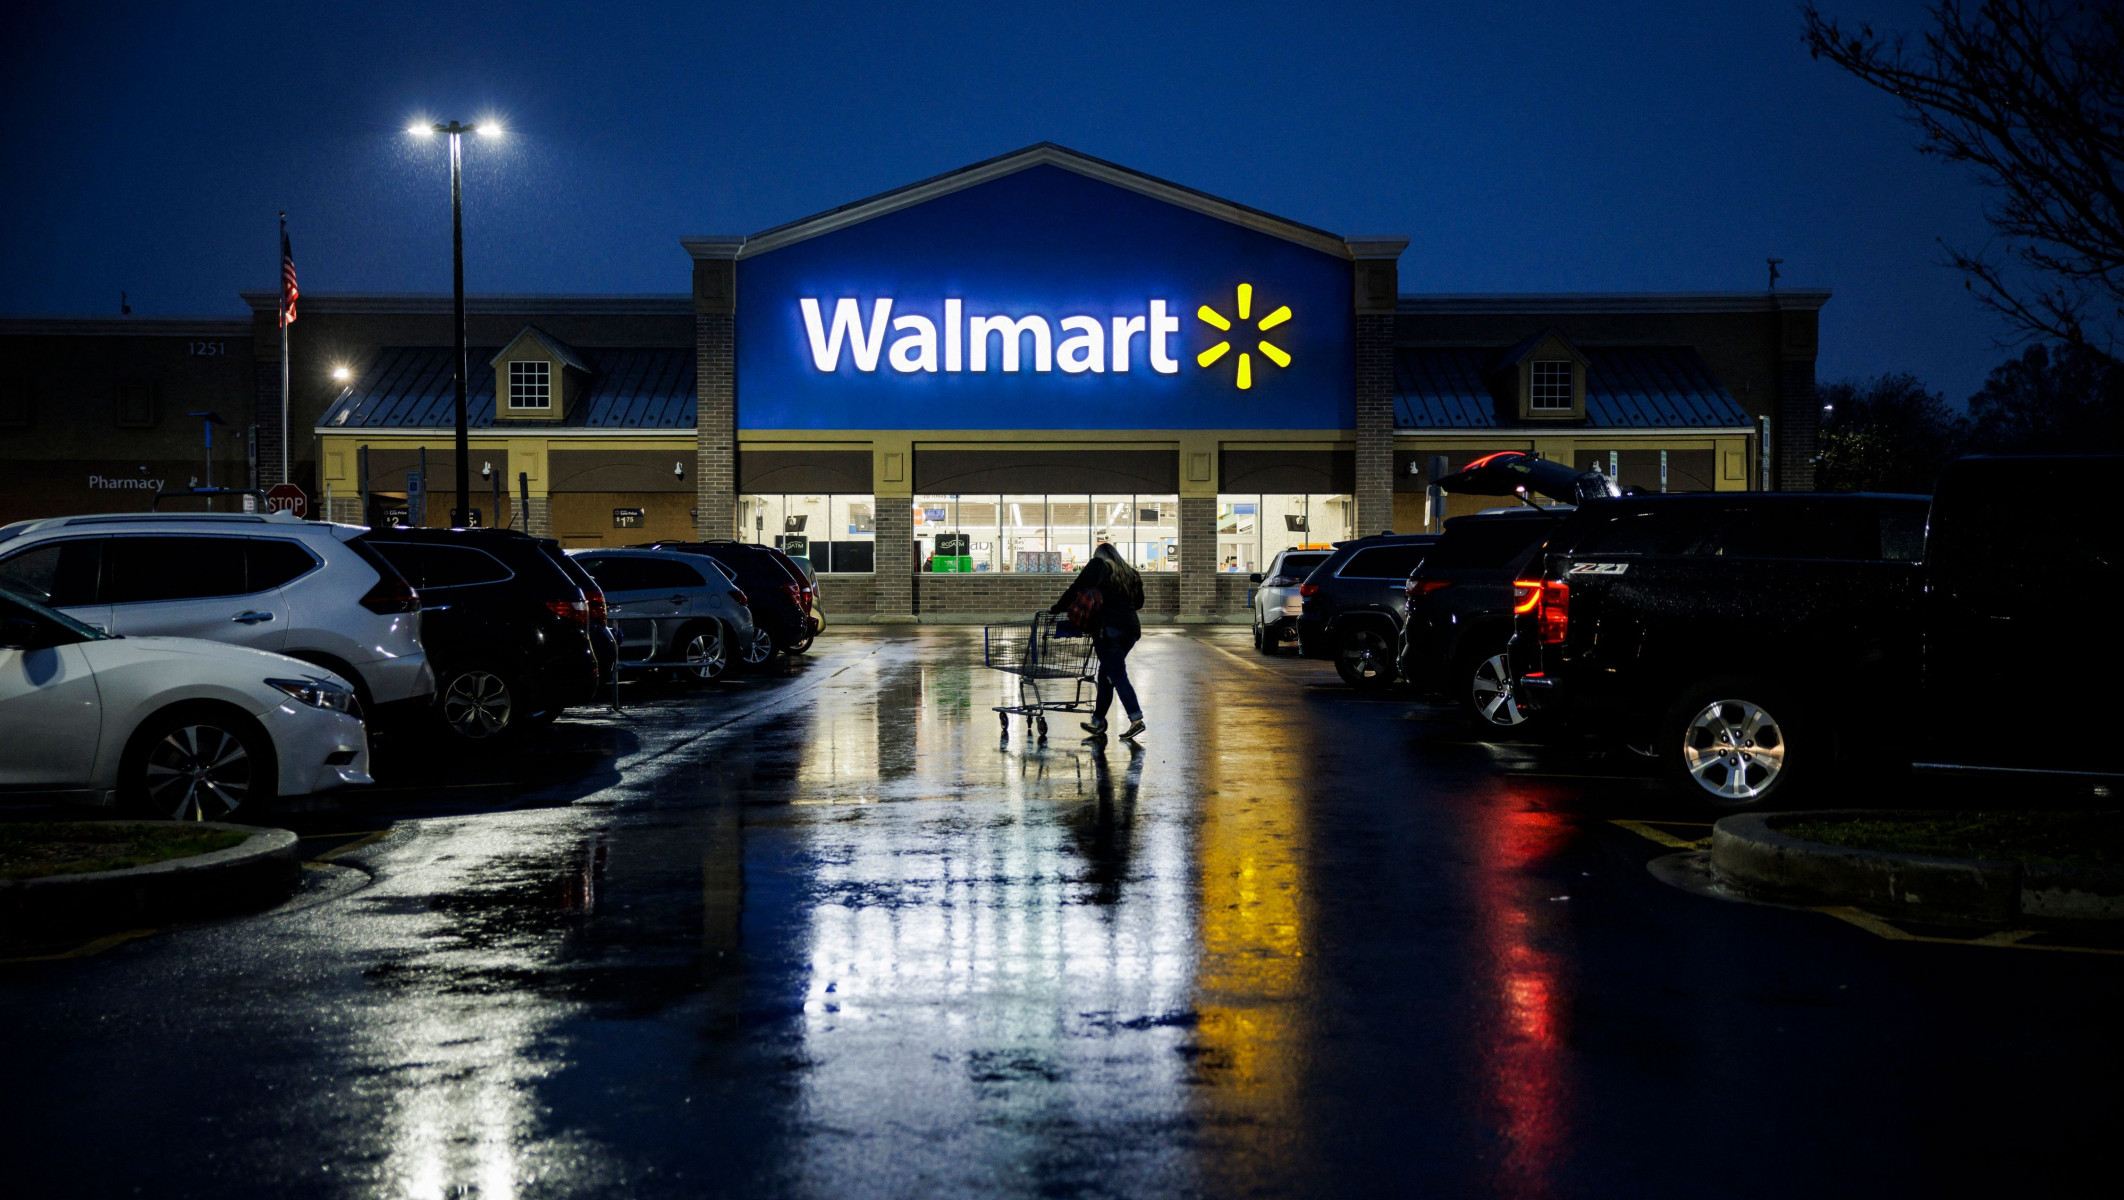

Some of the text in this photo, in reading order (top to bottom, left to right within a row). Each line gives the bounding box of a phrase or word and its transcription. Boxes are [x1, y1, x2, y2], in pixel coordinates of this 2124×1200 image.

[800, 298, 1178, 374] Walmart
[189, 342, 225, 356] 1251
[89, 475, 165, 492] Pharmacy
[269, 497, 304, 512] STOP
[1569, 562, 1629, 575] Z71
